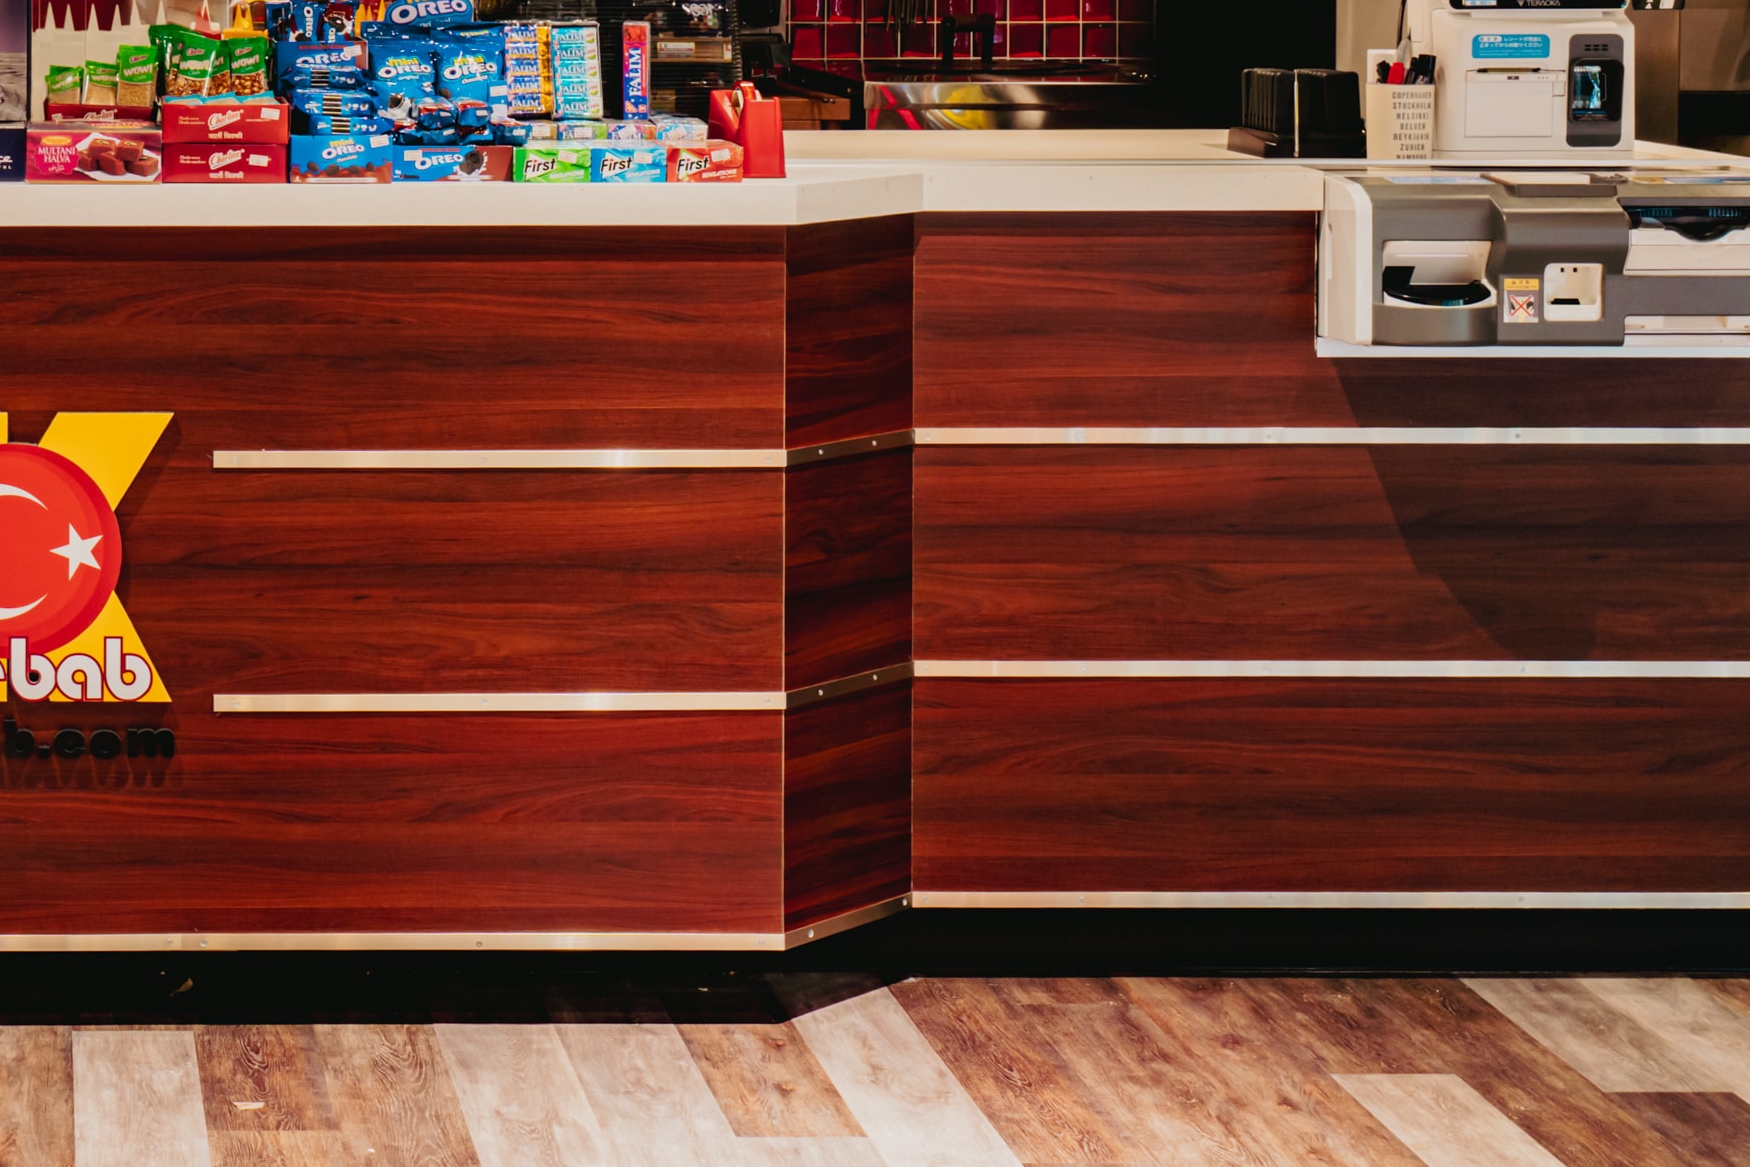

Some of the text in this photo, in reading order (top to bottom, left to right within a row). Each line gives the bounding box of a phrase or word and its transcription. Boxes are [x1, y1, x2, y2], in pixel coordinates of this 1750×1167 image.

[1526, 0, 1561, 7] TERAOKA
[390, 0, 468, 24] OREO
[303, 6, 313, 38] OREO
[556, 49, 584, 58] FALIM
[377, 64, 433, 79] OREO
[443, 63, 497, 79] OREO
[557, 66, 586, 74] FALIM
[629, 47, 642, 97] FALIM
[559, 84, 587, 93] FALIM
[512, 99, 539, 107] FALIM
[560, 102, 588, 111] FALIM
[1392, 101, 1432, 110] STOCKHOLM
[1396, 112, 1429, 120] HELSINKI
[329, 138, 355, 147] mini
[37, 146, 76, 155] MULTANI
[321, 143, 365, 160] OREO
[43, 154, 71, 163] HALVA
[414, 152, 464, 170] OREO
[524, 157, 556, 174] First
[601, 156, 632, 172] First
[677, 156, 709, 172] First
